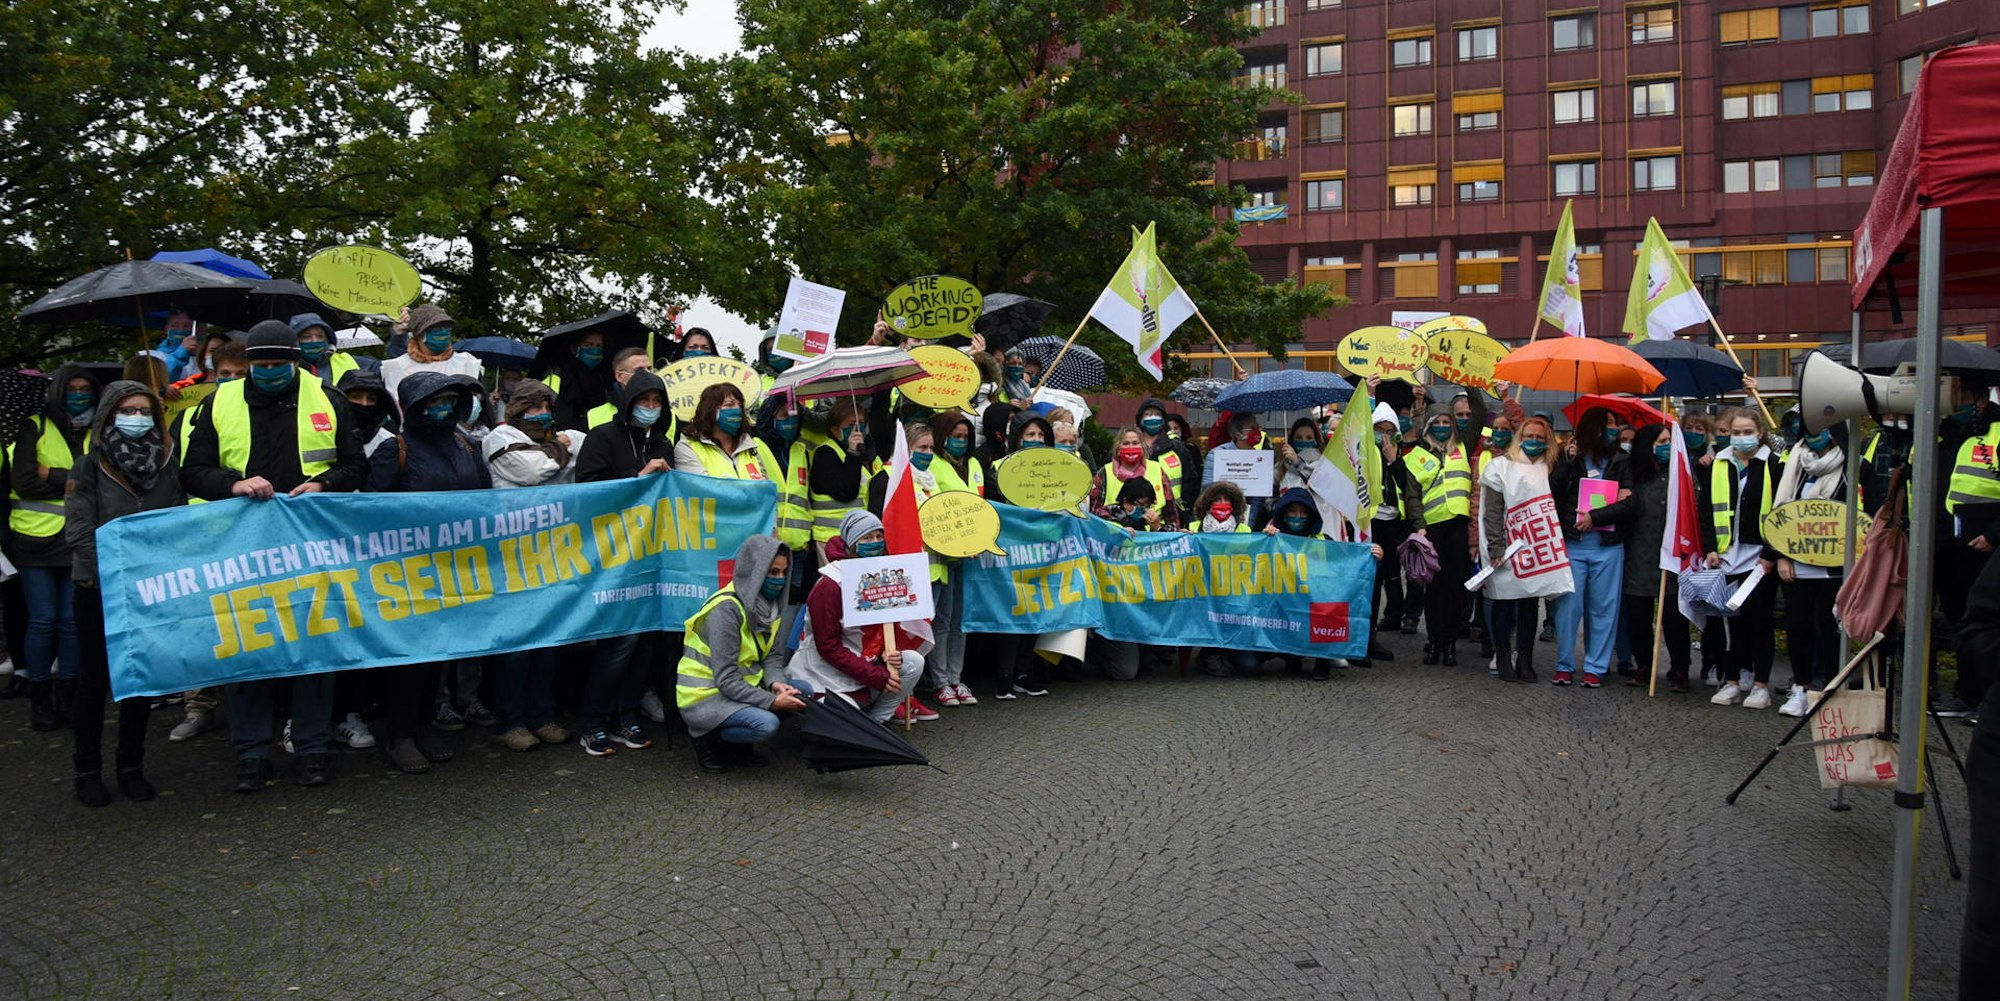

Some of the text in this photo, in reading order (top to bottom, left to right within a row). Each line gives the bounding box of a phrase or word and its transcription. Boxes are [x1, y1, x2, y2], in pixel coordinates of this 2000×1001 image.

[908, 277, 937, 293] THE
[884, 287, 979, 318] WORKING
[1350, 337, 1370, 351] Was
[1508, 501, 1555, 526] WEIL ES
[1768, 508, 1792, 529] WIR
[1797, 503, 1840, 518] LASSEN
[1796, 522, 1839, 535] NICHT
[136, 502, 570, 606] WIR HALTEN DEN LADEN AM LAUFEN.
[1133, 536, 1194, 560] LAUFEN.
[208, 497, 717, 660] JETZT SEID IHR DRAN!
[1011, 552, 1310, 616] JETZT EID IHR DRAN!
[656, 582, 698, 598] PWERED
[1289, 620, 1302, 632] BY
[1312, 626, 1346, 637] ver.di
[1819, 707, 1844, 725] ICH
[1824, 744, 1855, 762] WAS
[1825, 763, 1849, 781] BEI
